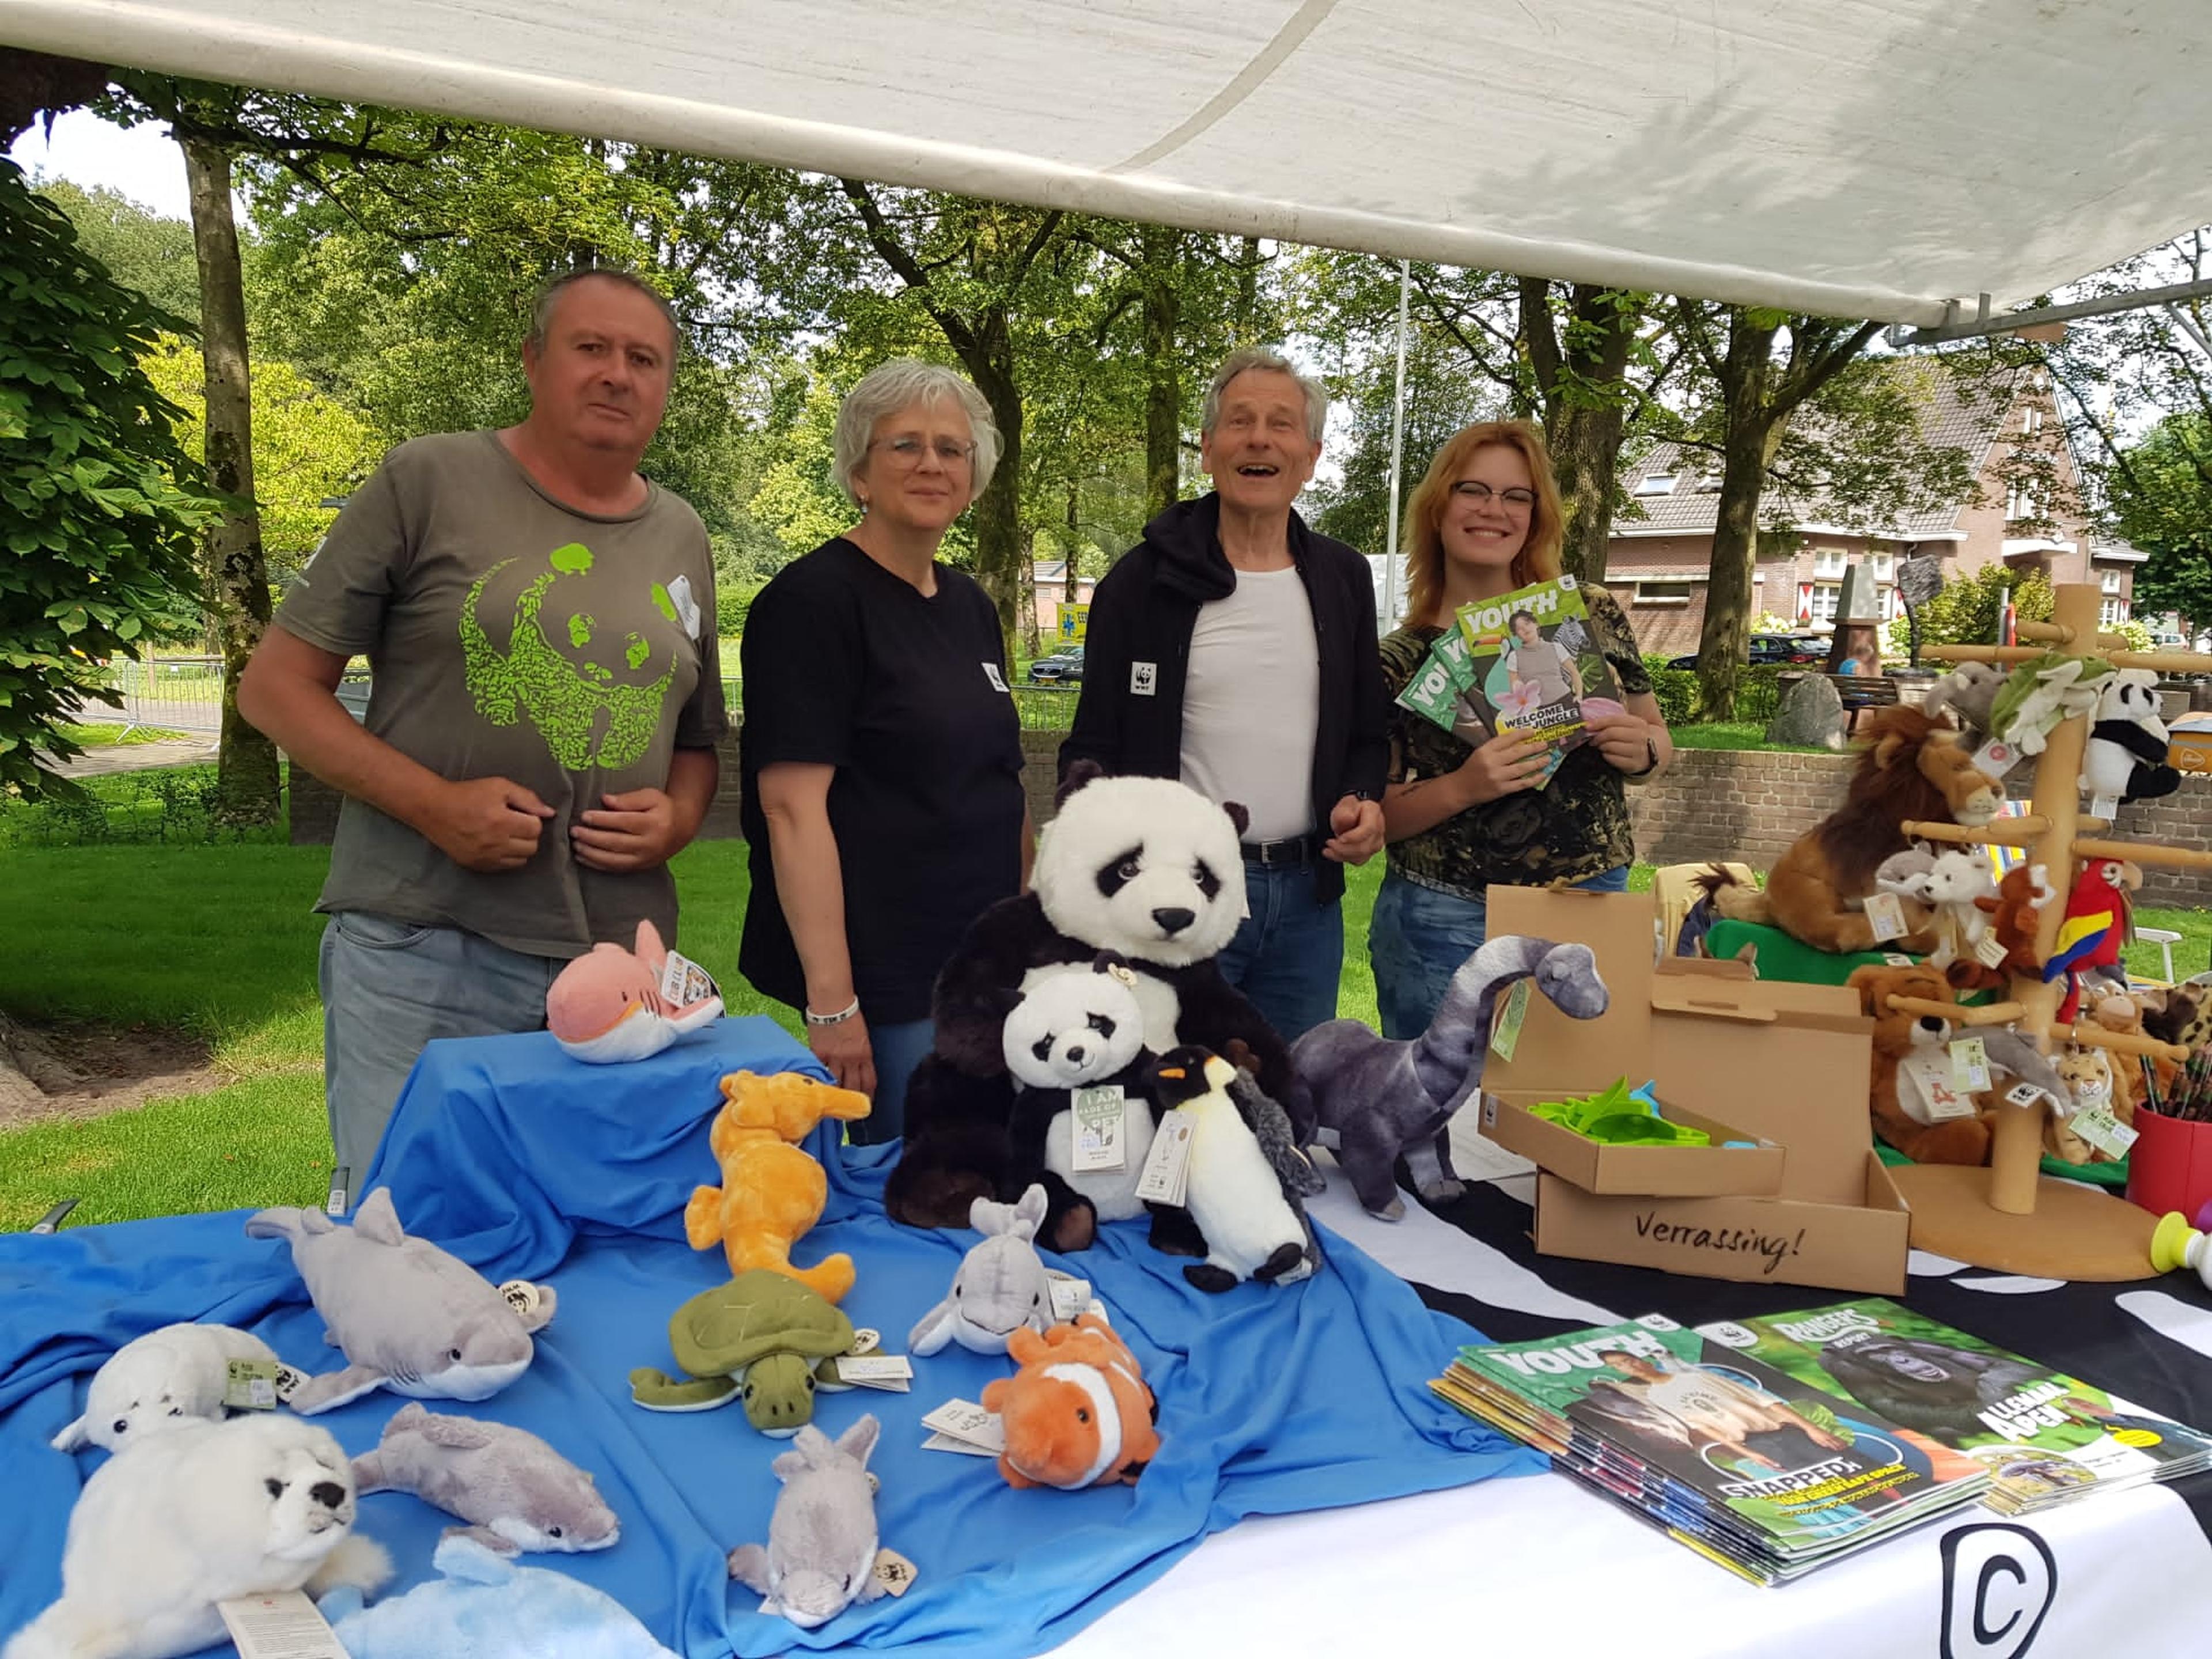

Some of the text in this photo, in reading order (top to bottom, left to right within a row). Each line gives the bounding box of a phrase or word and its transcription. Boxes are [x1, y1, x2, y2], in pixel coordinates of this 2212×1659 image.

[1505, 704, 1563, 729] WELCOME
[1636, 1211, 1806, 1275] Verrassing!
[1771, 1308, 1880, 1343] RANGERS
[1487, 1330, 1669, 1376] YOUTH
[1994, 1403, 2072, 1442] APEN
